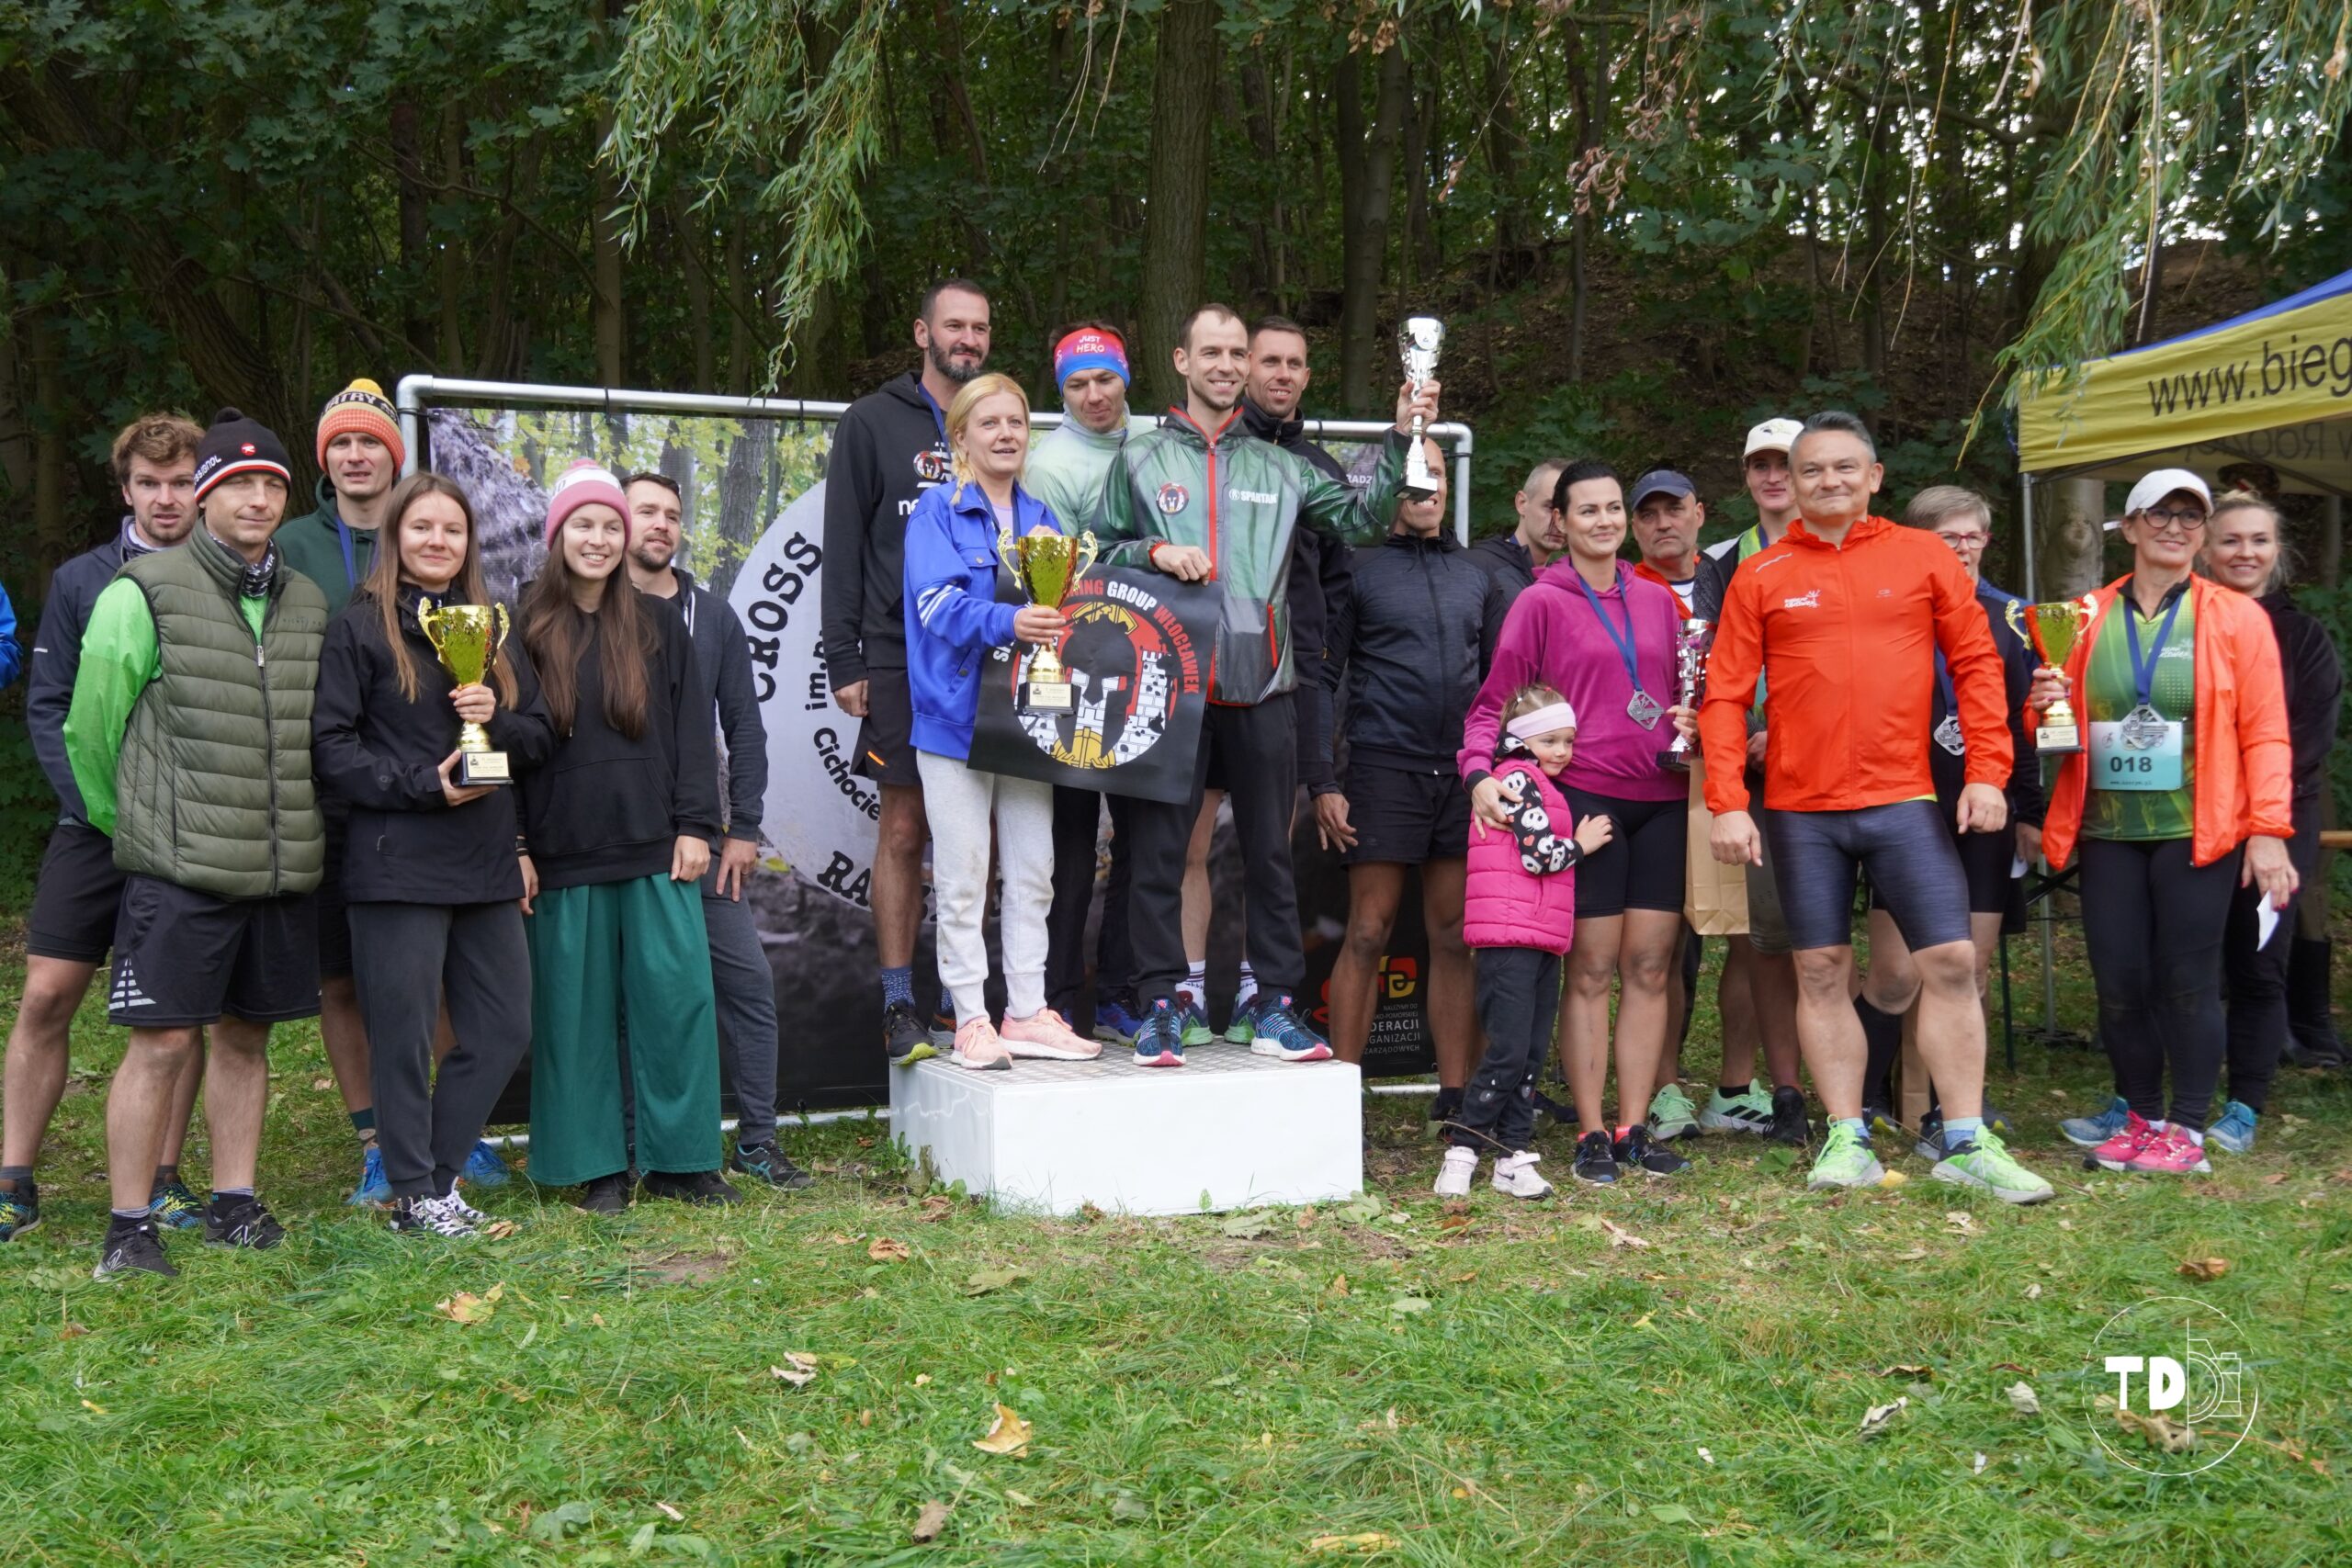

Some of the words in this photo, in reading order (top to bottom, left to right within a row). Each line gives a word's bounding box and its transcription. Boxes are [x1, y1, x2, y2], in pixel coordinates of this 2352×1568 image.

[1076, 344, 1105, 354] HERO
[1240, 491, 1278, 504] SPARTAN
[1106, 581, 1158, 612] GROUP
[1153, 604, 1200, 694] WŁOCŁAWEK
[2109, 756, 2153, 773] 018
